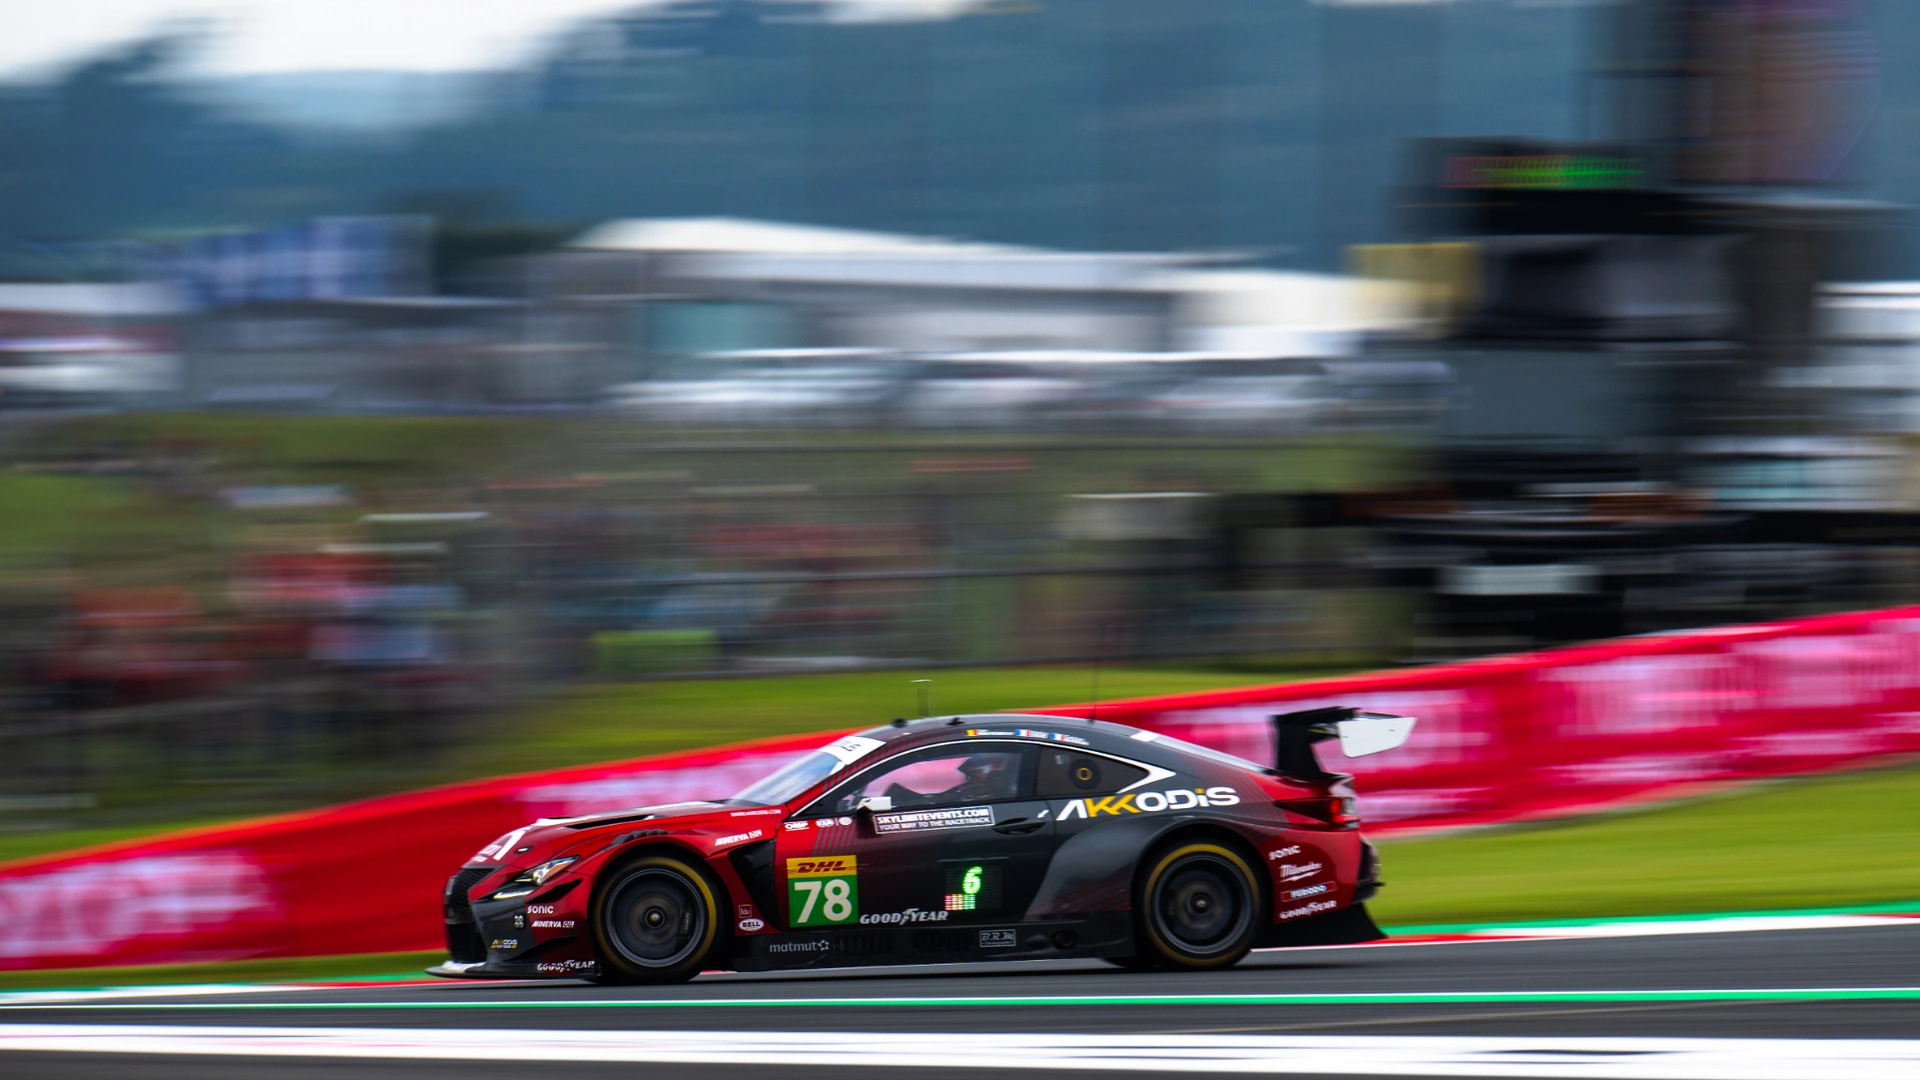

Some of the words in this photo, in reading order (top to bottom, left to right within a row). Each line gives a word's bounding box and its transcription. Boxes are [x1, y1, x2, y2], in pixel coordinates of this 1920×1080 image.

[877, 809, 990, 824] SKYLIMITEVENTS.COM
[878, 823, 901, 831] YOUR
[901, 821, 917, 829] WAY
[930, 819, 945, 827] THE
[945, 816, 990, 825] RACETRACK
[714, 832, 750, 846] MINERVA
[797, 860, 847, 874] DHL
[963, 866, 983, 895] 6
[793, 879, 853, 924] 78
[531, 920, 562, 928] MINERVA
[859, 908, 949, 926] GOODYEAR
[769, 941, 818, 953] matmut
